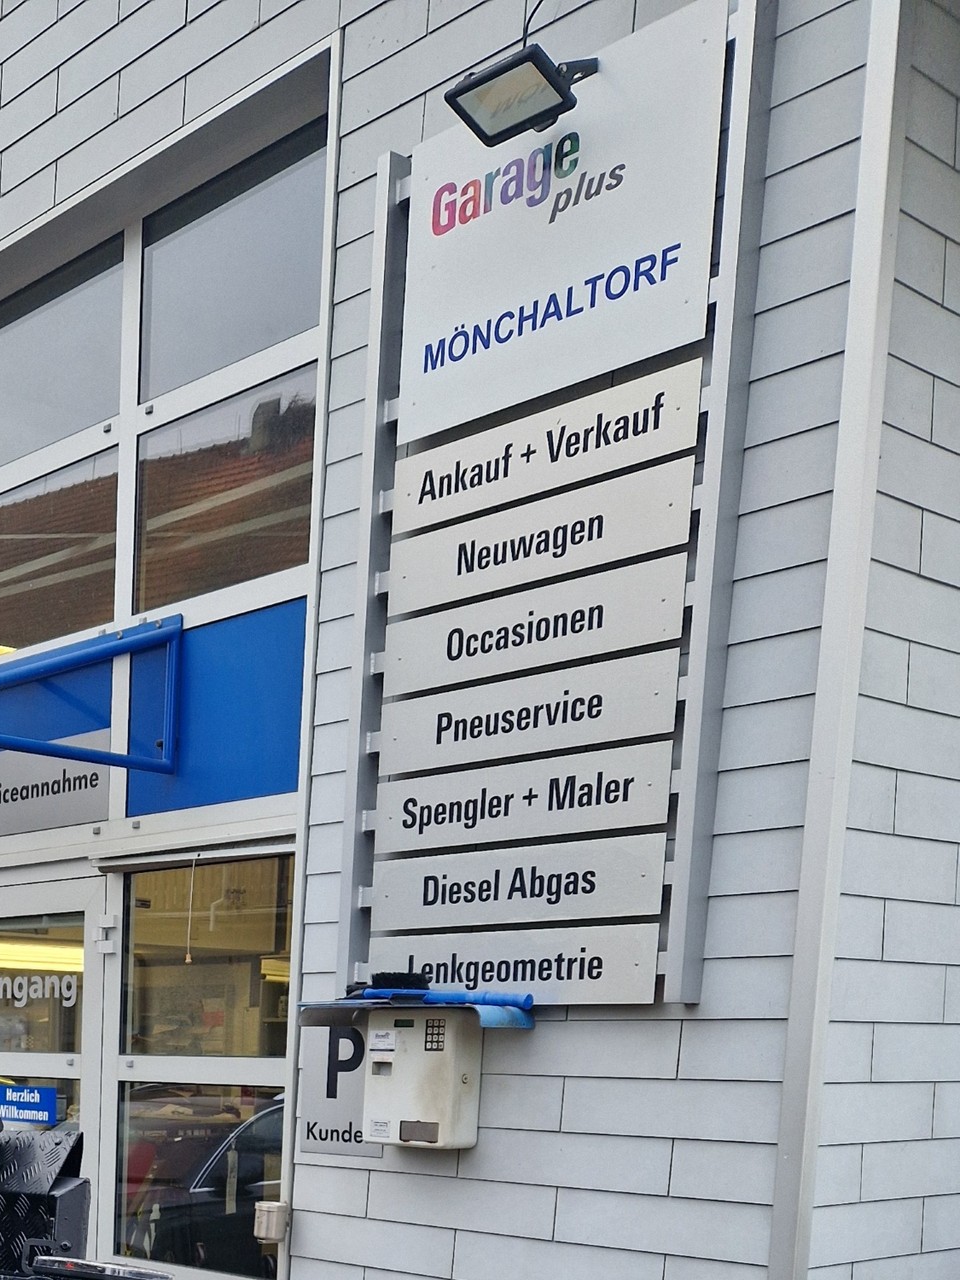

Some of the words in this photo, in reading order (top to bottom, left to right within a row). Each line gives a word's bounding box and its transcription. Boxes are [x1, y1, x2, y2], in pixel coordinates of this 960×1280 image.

[431, 131, 580, 237] Garage
[548, 163, 626, 224] plus
[423, 242, 682, 374] MÖNCHALTORF
[418, 443, 514, 505] Ankauf
[520, 444, 537, 464] +
[546, 391, 666, 463] Verkauf
[457, 514, 604, 576] Neuwagen
[446, 604, 604, 661] Occasionen
[436, 690, 603, 745] Pneuservice
[402, 787, 515, 835] Spengler
[522, 787, 539, 807] +
[547, 772, 635, 812] Maler
[422, 869, 500, 906] Diesel
[507, 866, 597, 905] Abgas
[326, 1026, 365, 1099] P
[6, 1087, 40, 1103] Herzlich
[306, 1121, 364, 1144] Kunde
